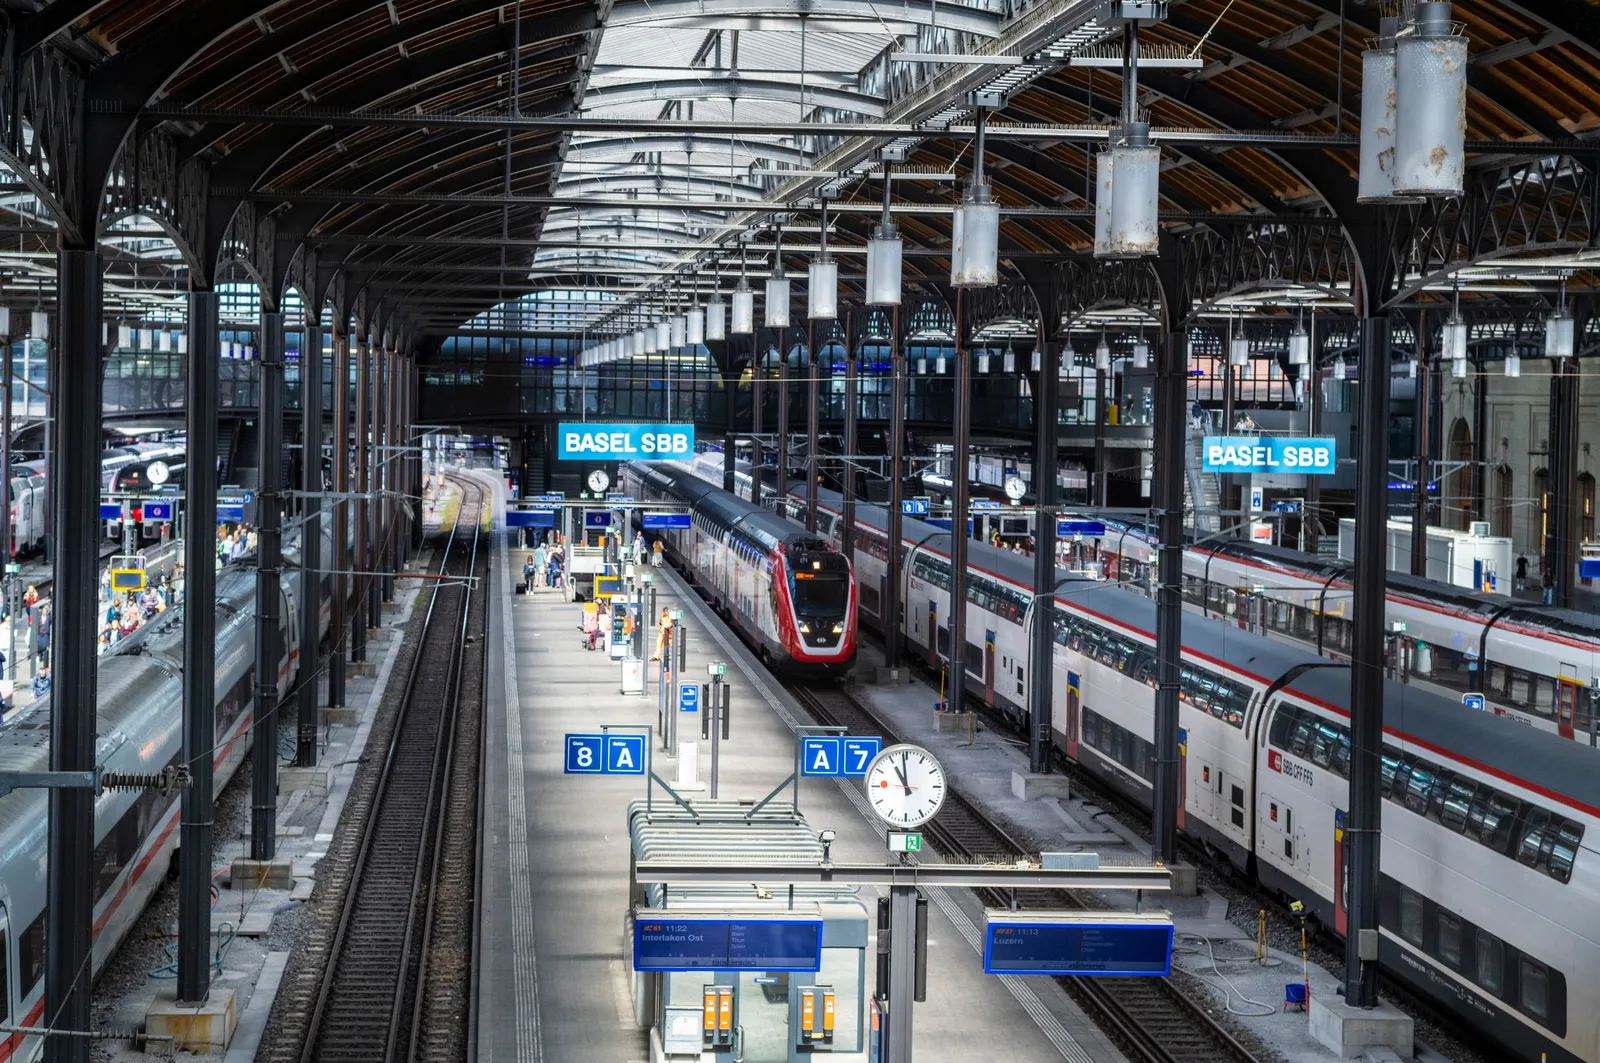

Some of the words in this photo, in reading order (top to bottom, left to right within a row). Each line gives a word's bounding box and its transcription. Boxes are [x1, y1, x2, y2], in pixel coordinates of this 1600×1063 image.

[566, 433, 637, 453] BASEL
[641, 433, 688, 453] SBB
[1209, 446, 1279, 466] BASEL
[1283, 446, 1329, 467] SBB
[577, 747, 592, 767] 8
[616, 747, 634, 768] A
[813, 749, 830, 770] A
[854, 750, 868, 770] 7
[1283, 758, 1293, 776] SBB
[1293, 763, 1303, 781] CFF
[1303, 768, 1313, 787] FFS
